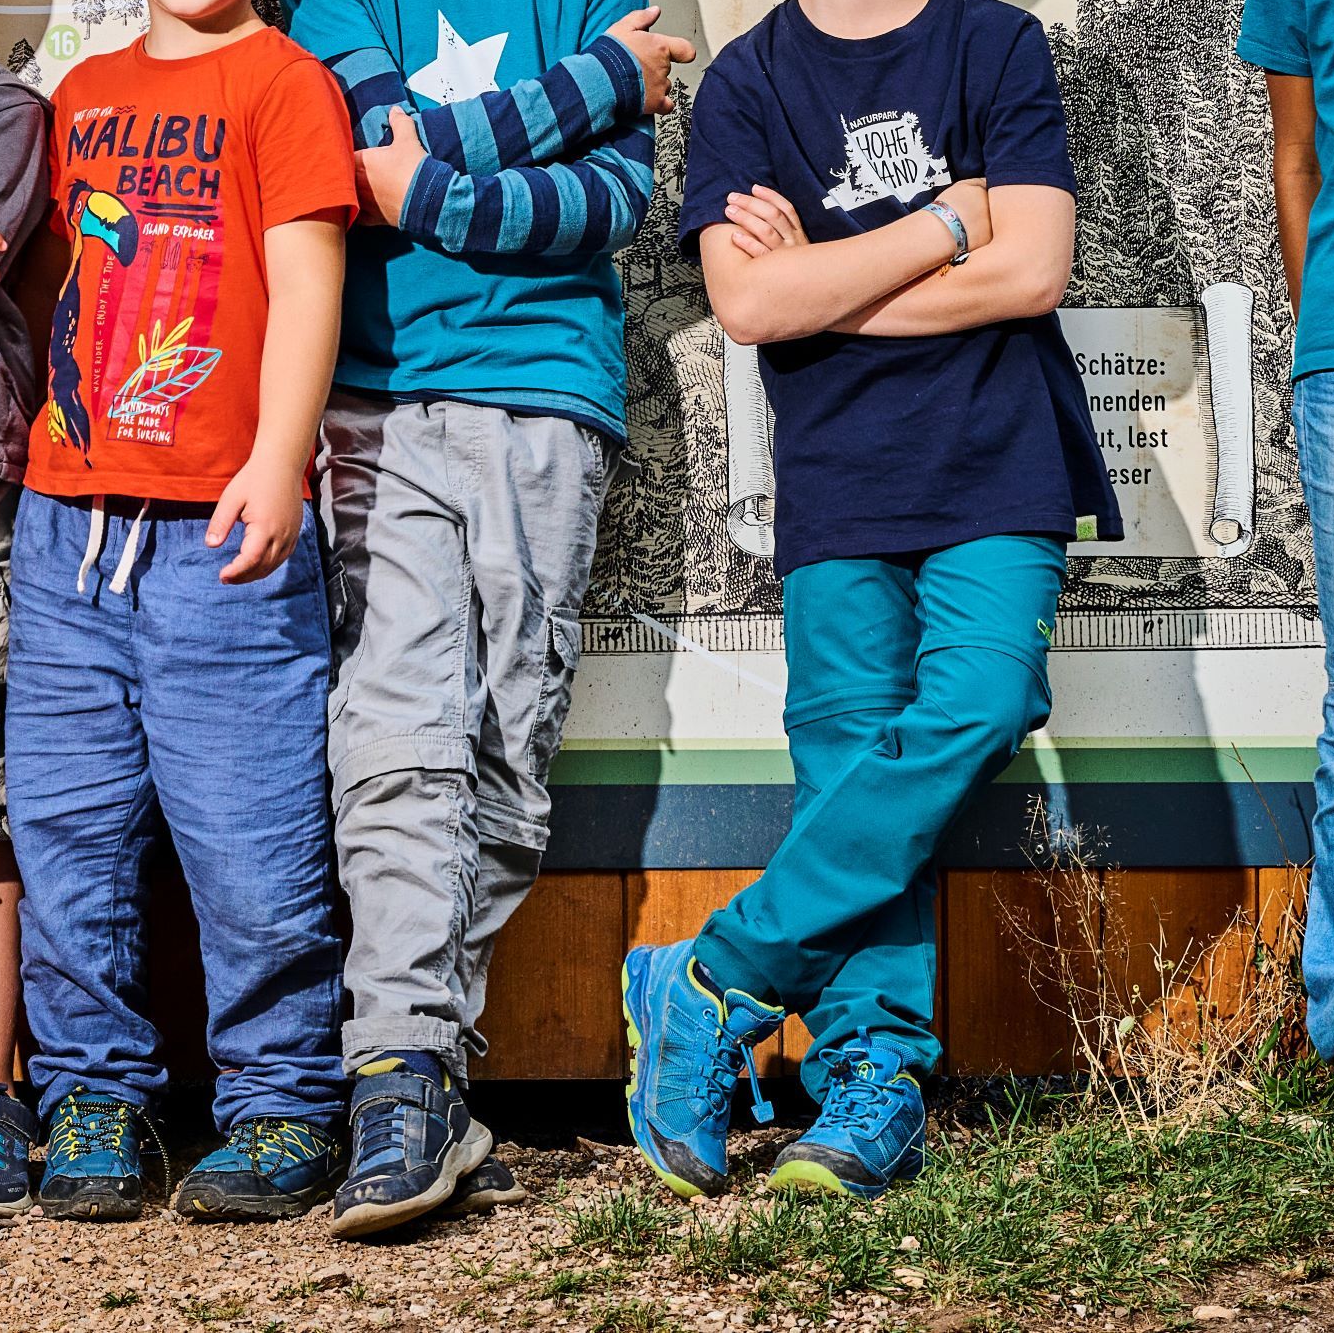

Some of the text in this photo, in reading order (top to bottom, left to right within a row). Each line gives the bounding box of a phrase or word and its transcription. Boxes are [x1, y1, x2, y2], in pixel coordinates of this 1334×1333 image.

[50, 31, 74, 56] 16
[849, 110, 898, 130] NATURPARK
[67, 113, 226, 167] MALIBU
[855, 125, 908, 161] HOHE
[116, 164, 221, 199] BEACH
[142, 223, 215, 241] ISLAND EXPLORER
[103, 254, 116, 278] TIDE
[99, 277, 111, 298] THE
[95, 338, 104, 359] RIDER
[1075, 353, 1165, 375] Schätze:
[119, 414, 160, 428] ARE MADE
[117, 426, 171, 443] FOR SURFING
[1129, 426, 1168, 447] lest
